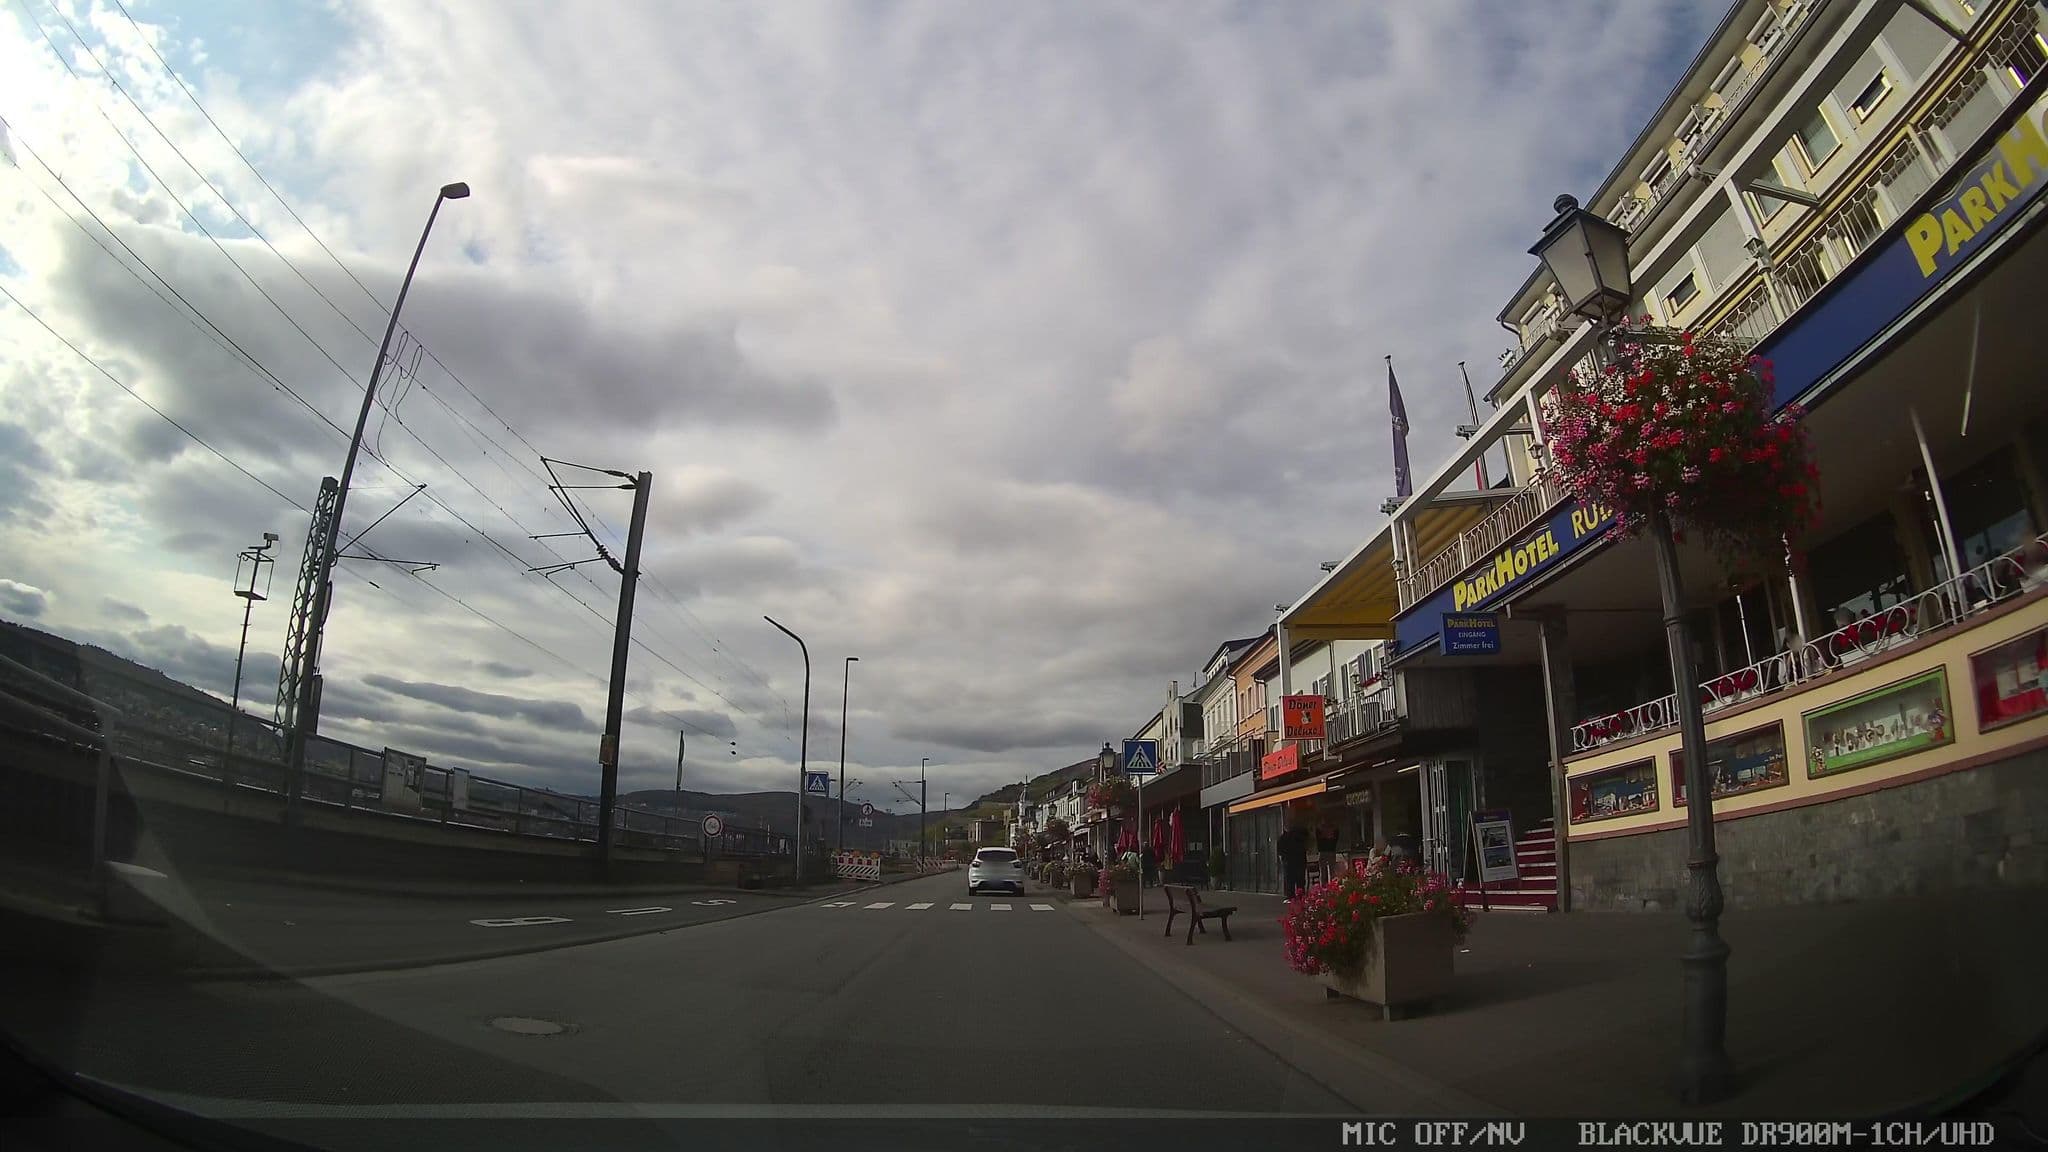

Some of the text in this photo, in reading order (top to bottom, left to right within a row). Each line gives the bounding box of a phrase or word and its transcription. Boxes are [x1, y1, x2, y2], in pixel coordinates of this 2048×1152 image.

[1453, 530, 1560, 612] PARKHOTEL
[1447, 618, 1496, 629] PARKHOTEL
[1452, 641, 1495, 650] Zimmer frei
